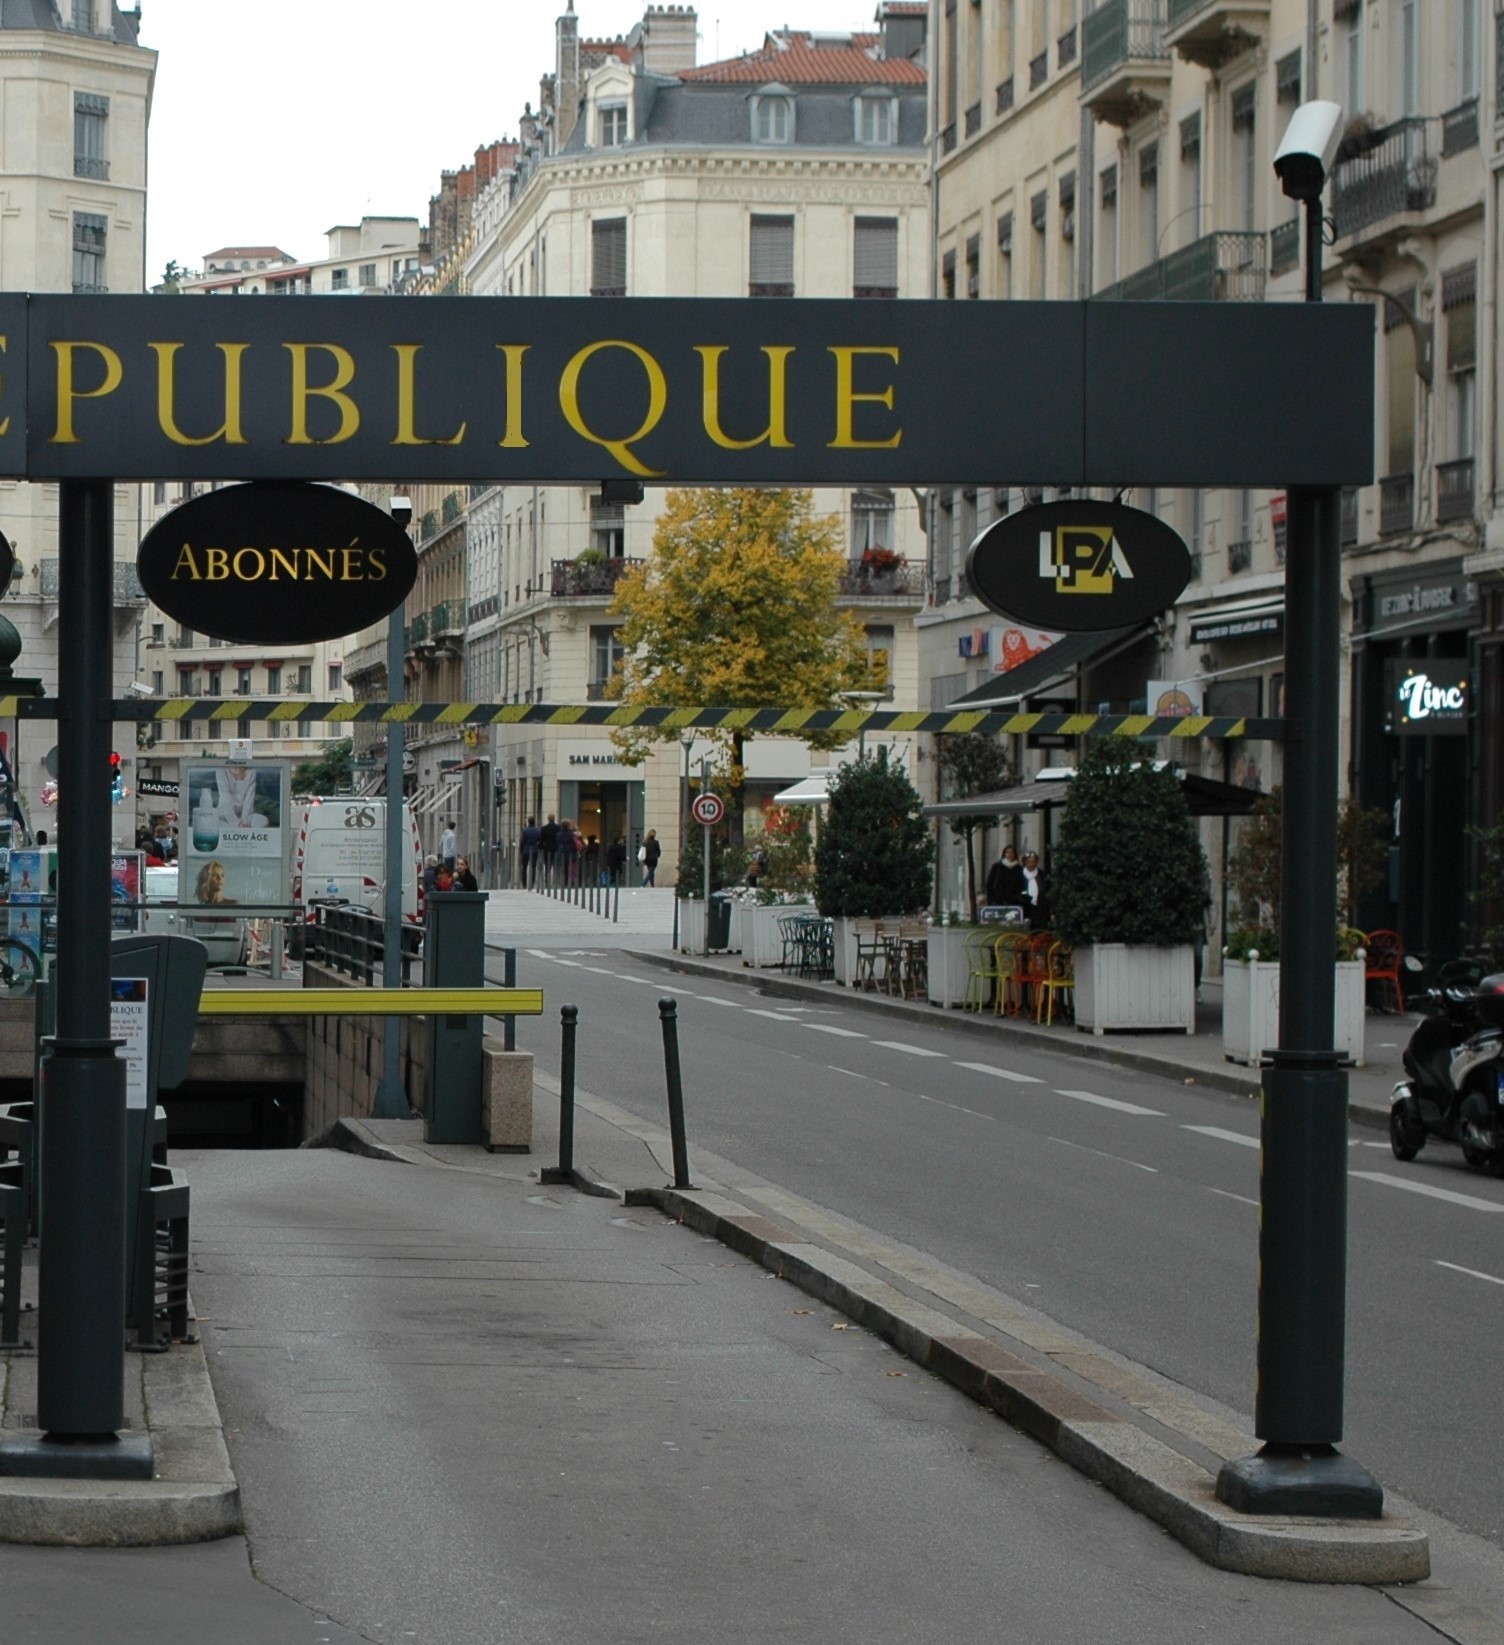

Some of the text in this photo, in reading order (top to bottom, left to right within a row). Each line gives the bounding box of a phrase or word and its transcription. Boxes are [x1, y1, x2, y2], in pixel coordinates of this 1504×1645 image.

[169, 536, 388, 581] ABONNÉS
[1038, 525, 1135, 588] LPA
[1402, 673, 1464, 719] Zinc
[569, 754, 590, 765] SAN
[142, 782, 179, 794] MANGO
[344, 805, 376, 829] as
